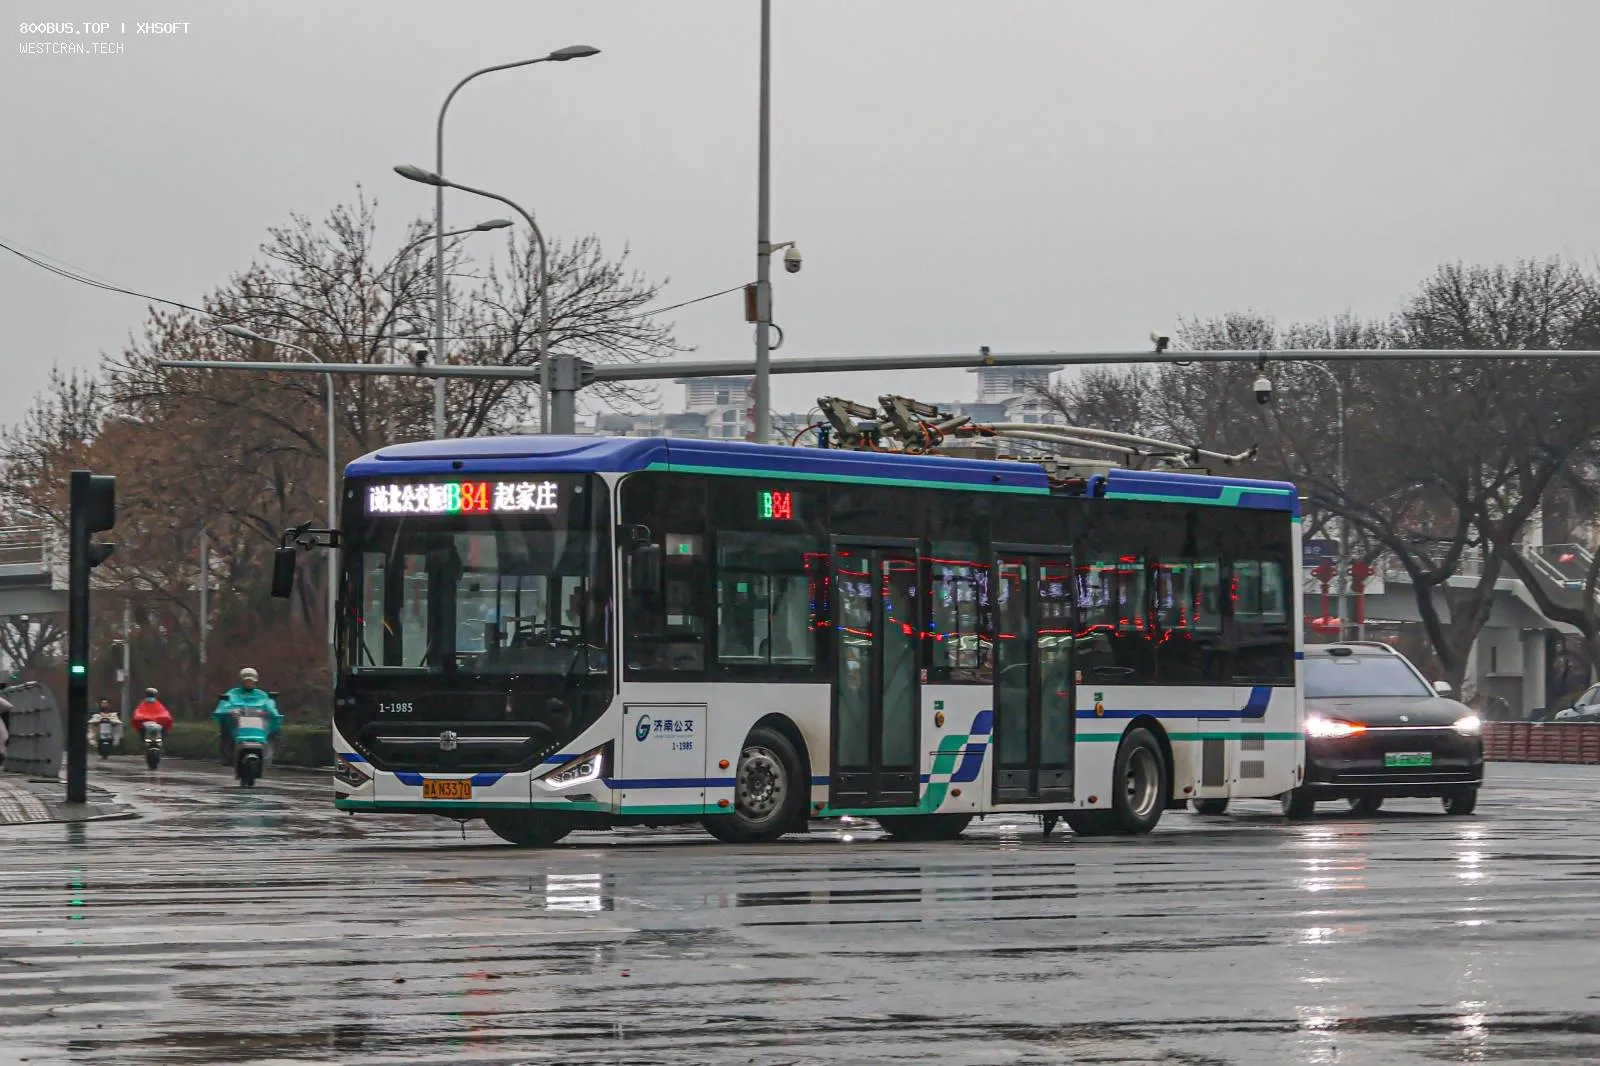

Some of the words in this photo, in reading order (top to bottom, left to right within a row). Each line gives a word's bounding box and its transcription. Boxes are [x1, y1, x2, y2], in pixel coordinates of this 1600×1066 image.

[494, 481, 558, 510] 赵家庄
[763, 492, 790, 519] B84
[379, 703, 413, 713] 1-1985
[653, 719, 694, 732] 济南公交
